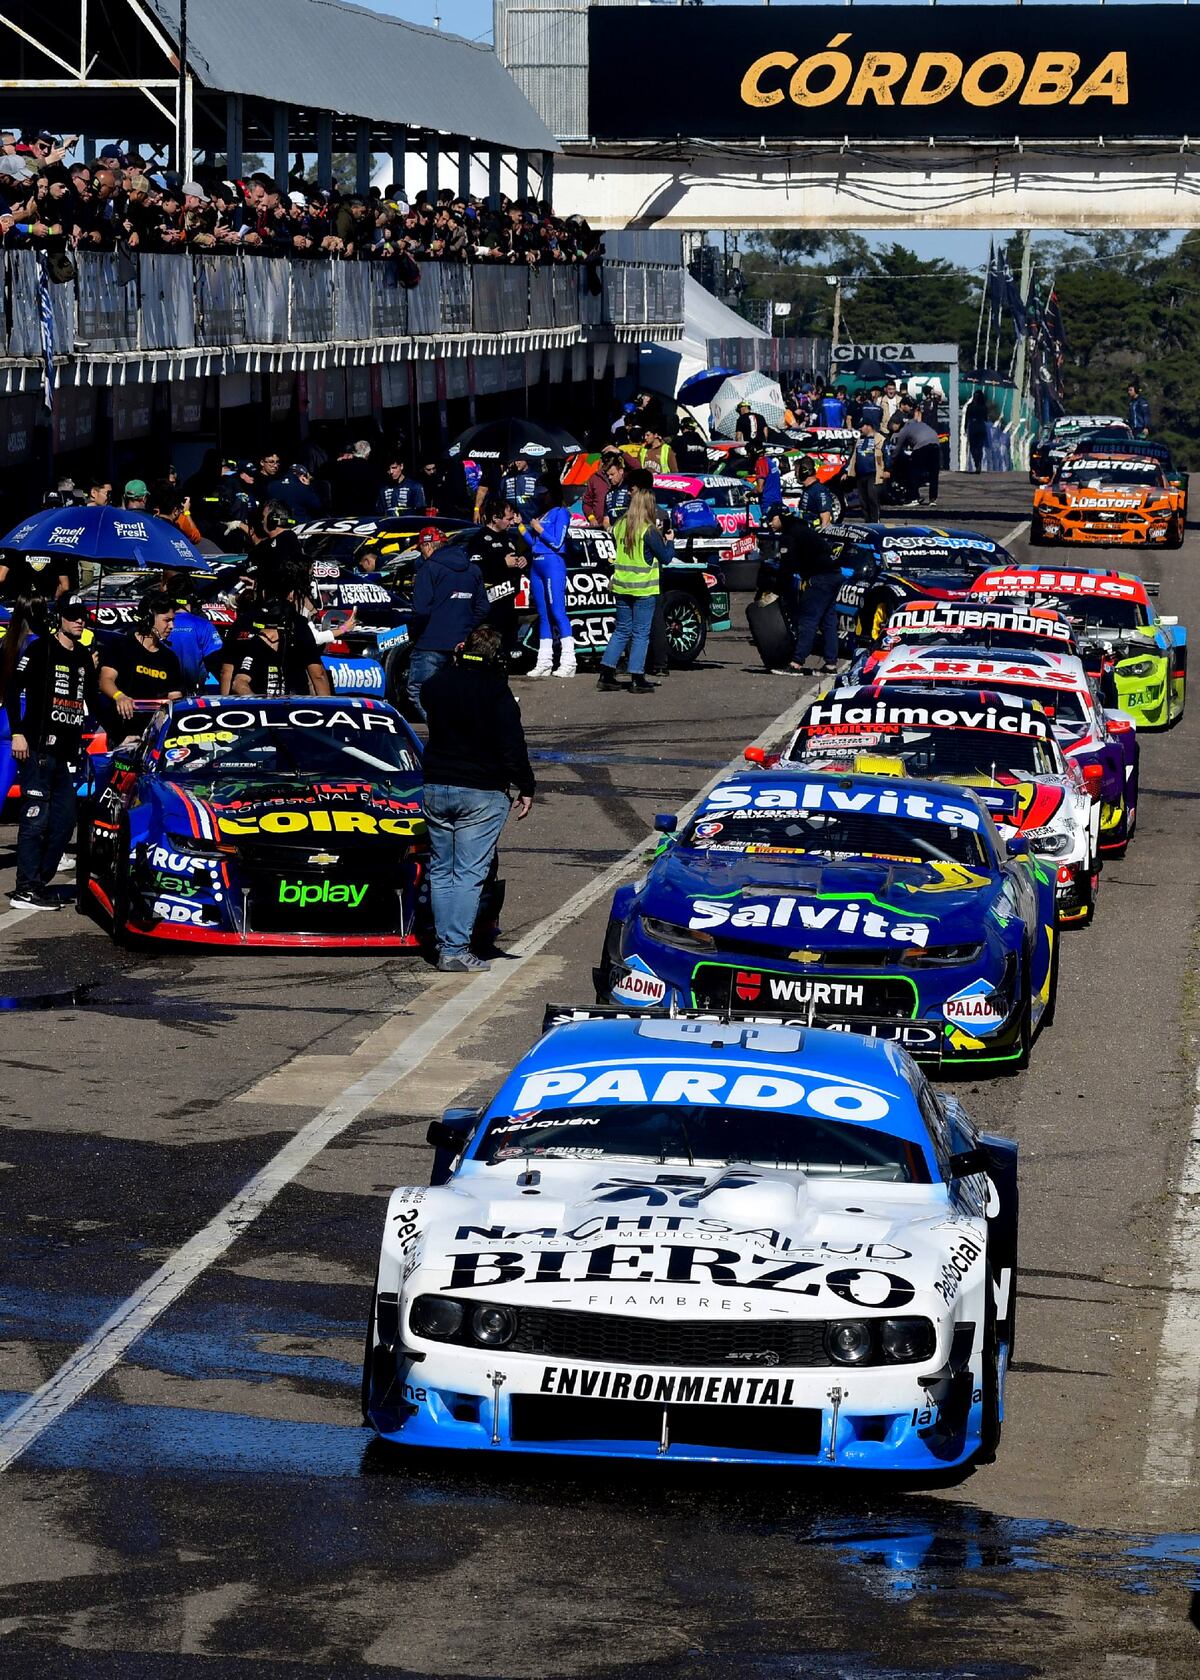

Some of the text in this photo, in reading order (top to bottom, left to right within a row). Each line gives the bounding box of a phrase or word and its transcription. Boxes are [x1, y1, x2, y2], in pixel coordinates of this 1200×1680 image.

[740, 33, 1129, 107] CÓRDOBA
[817, 430, 861, 440] PARDO
[52, 526, 86, 536] Smell
[113, 521, 145, 530] Smell
[116, 529, 148, 538] Fresh
[48, 534, 80, 544] Fresh
[882, 537, 997, 553] AgroSpray
[985, 573, 1136, 595] milla
[888, 610, 1070, 640] MULTIBANDAS
[377, 632, 410, 652] CHEMES
[136, 664, 167, 680] COIRO
[886, 662, 1077, 684] ARIAS
[177, 710, 398, 733] COLCAR
[809, 701, 1048, 737] Haimovich
[164, 731, 234, 748] COIRO
[807, 725, 900, 736] HAMILTON
[705, 784, 980, 829] Salvita
[217, 811, 427, 836] COIRO
[279, 880, 369, 907] bplay
[689, 897, 930, 947] Salvita
[769, 979, 863, 1006] WÜRTH
[513, 1069, 890, 1121] PARDO
[544, 1146, 604, 1154] CRISTEM
[440, 1244, 915, 1309] BIERZO
[588, 1295, 753, 1312] FIAMBRES
[540, 1366, 795, 1406] ENVIRONMENTAL
